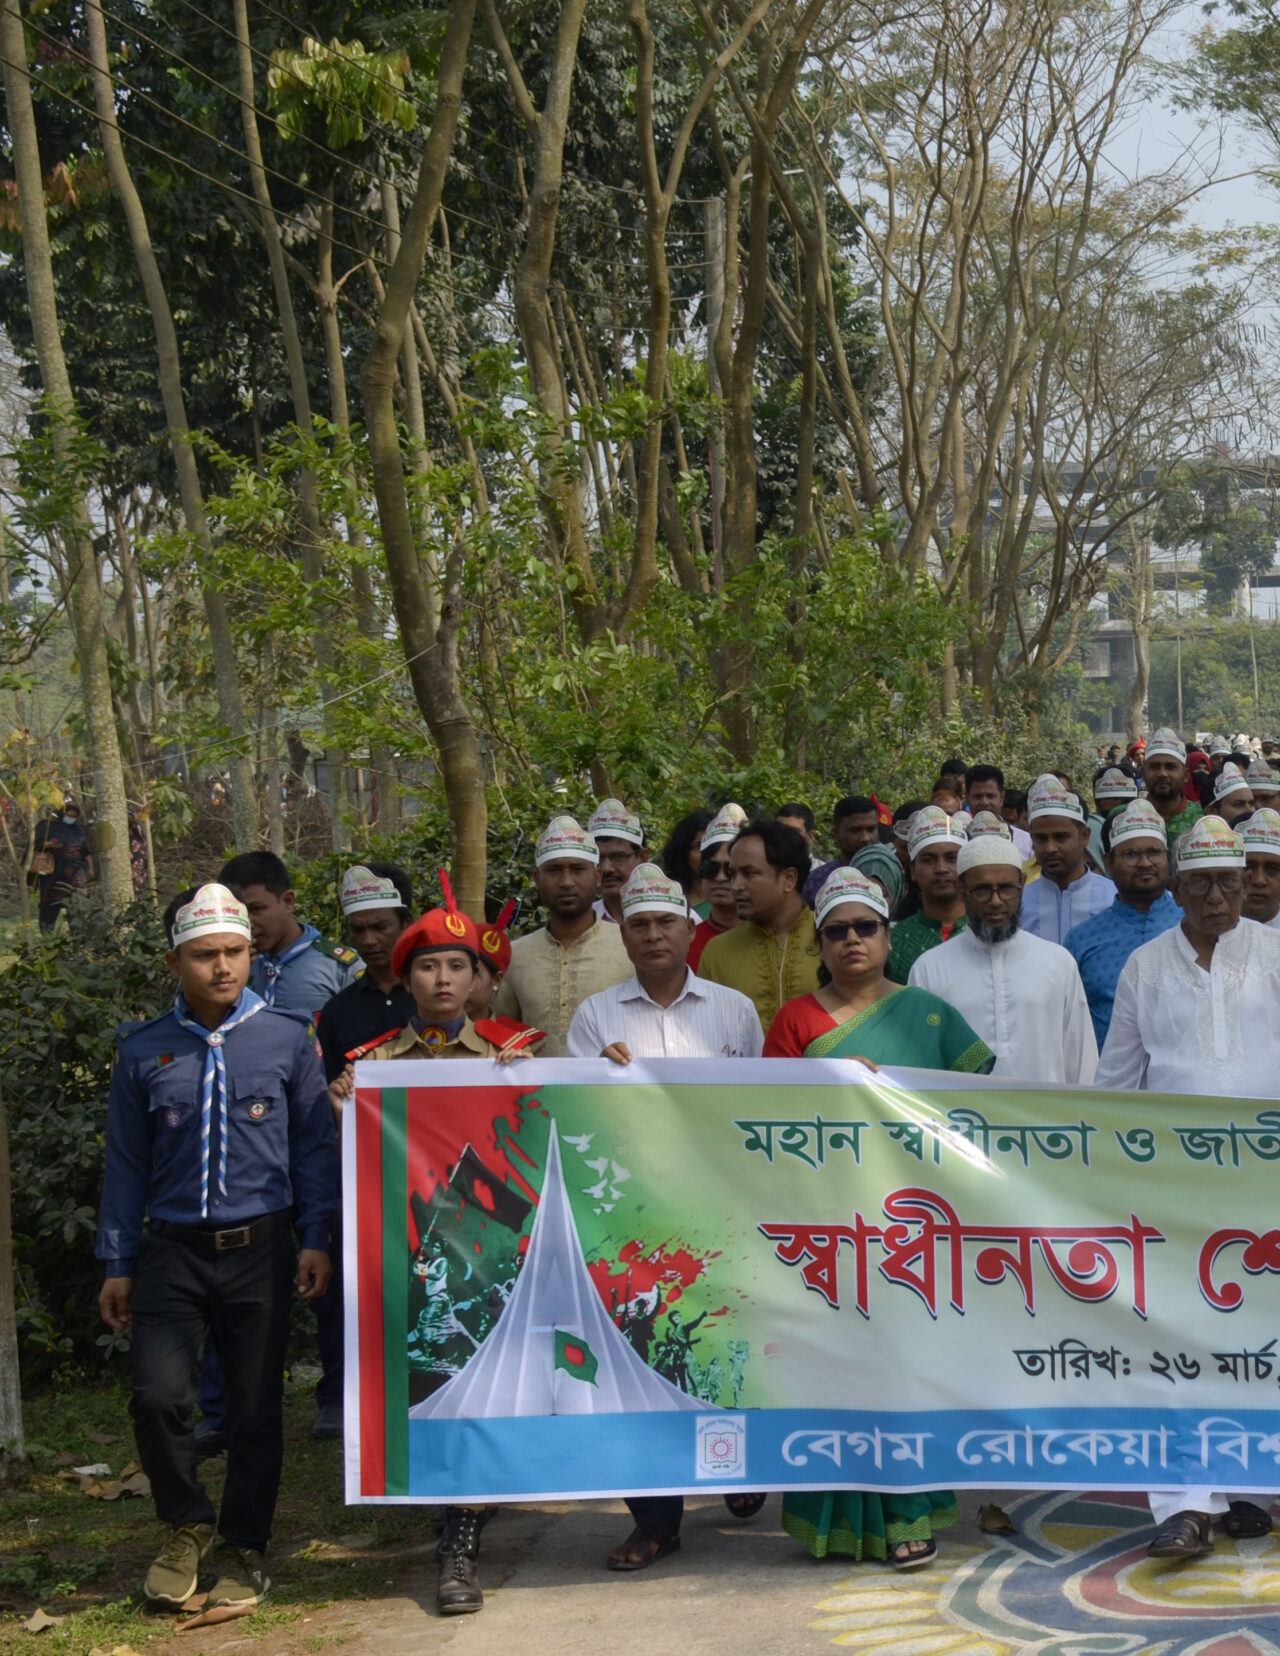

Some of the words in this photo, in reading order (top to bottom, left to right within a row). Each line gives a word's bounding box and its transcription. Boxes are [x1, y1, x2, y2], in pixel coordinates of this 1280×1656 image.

[733, 1114, 871, 1170] মহান
[878, 1107, 1098, 1168] স্বাধীনতা
[1114, 1126, 1158, 1165] ও
[757, 1186, 1167, 1320] স্বাধীনতা
[1149, 1350, 1201, 1385] ২৬
[781, 1425, 934, 1471] বেগম
[956, 1423, 1176, 1469] রোকেয়া
